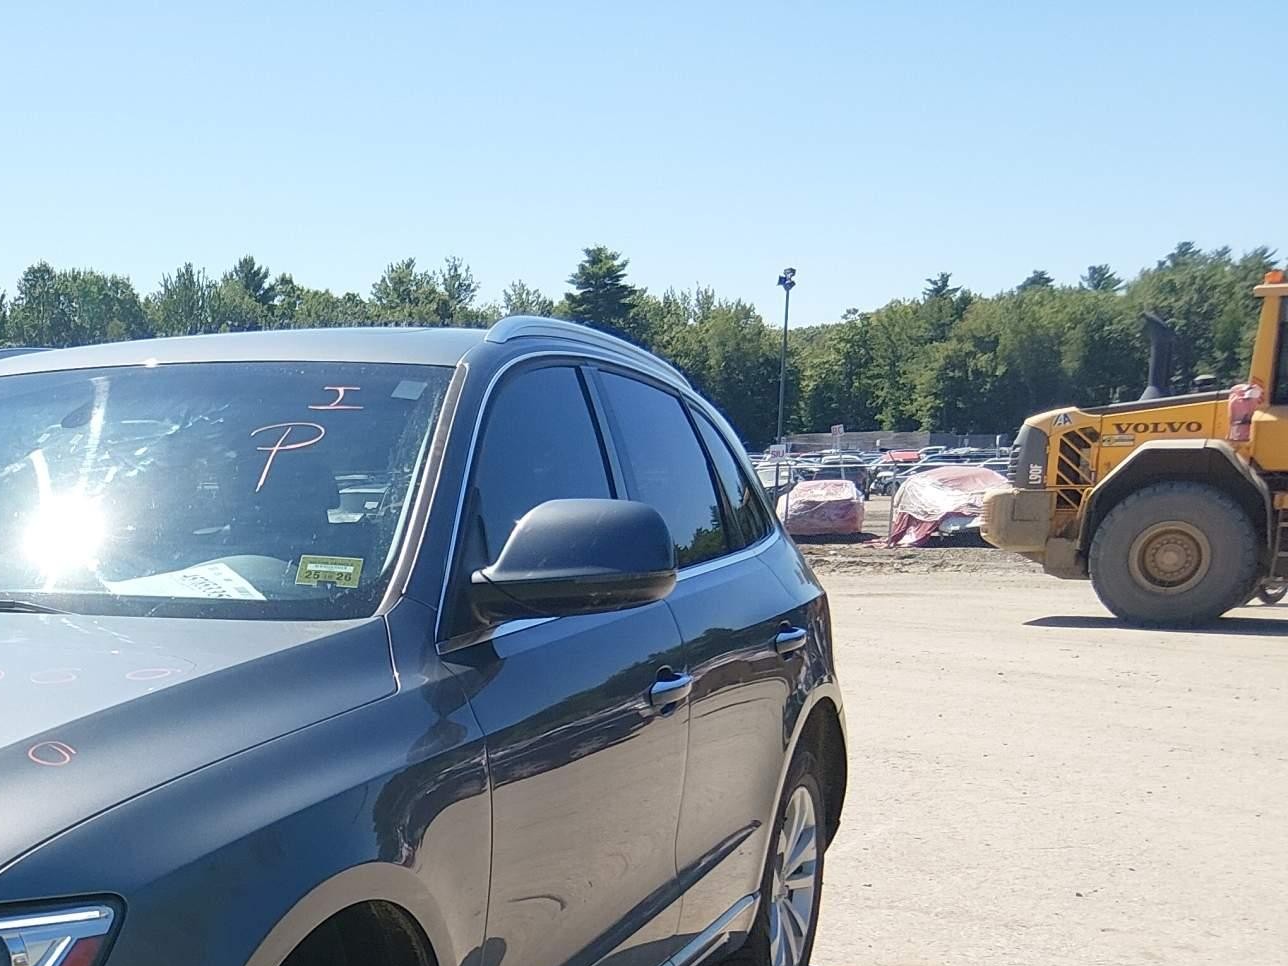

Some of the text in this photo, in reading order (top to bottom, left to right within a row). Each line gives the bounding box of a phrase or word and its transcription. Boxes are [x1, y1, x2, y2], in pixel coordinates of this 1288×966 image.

[1113, 421, 1203, 434] VOLVO
[251, 421, 325, 493] P
[1028, 463, 1043, 484] L90F
[305, 570, 321, 580] 25
[335, 571, 352, 582] 26
